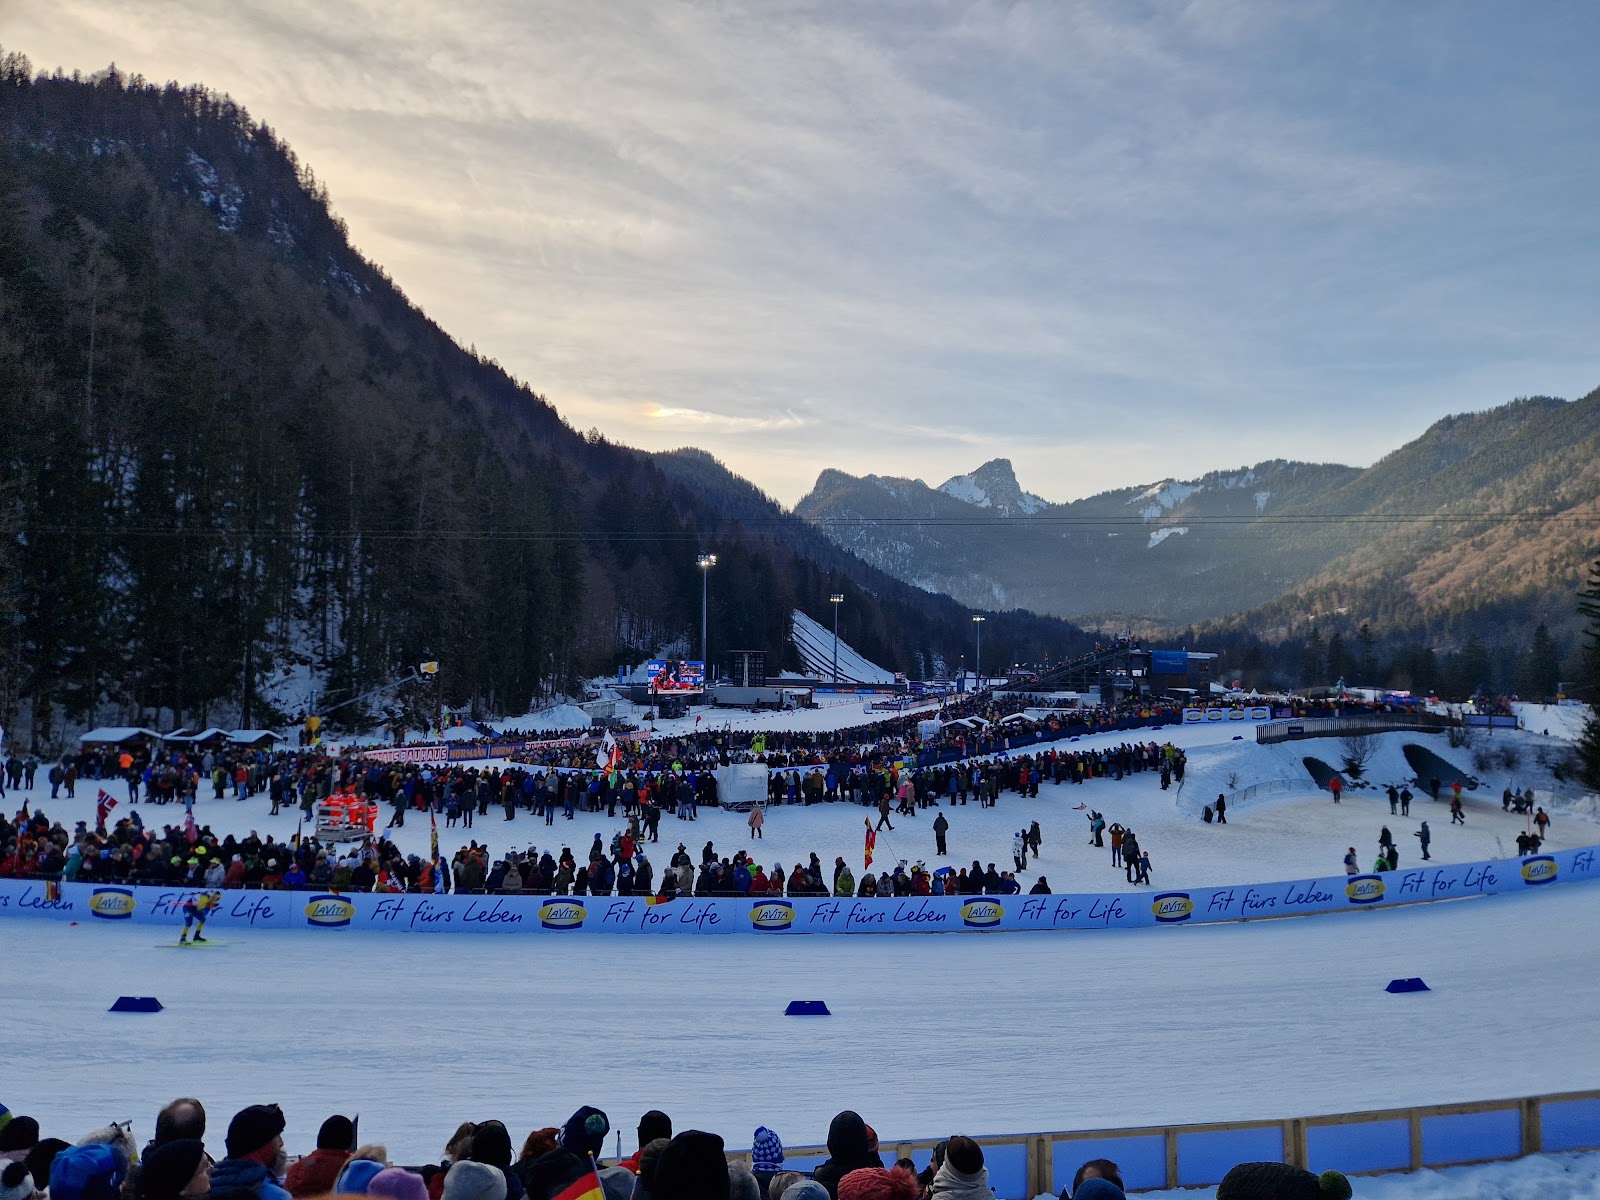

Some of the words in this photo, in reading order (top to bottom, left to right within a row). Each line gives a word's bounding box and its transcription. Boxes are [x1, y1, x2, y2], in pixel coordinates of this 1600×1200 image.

[401, 749, 447, 763] BAUHAUS
[1572, 850, 1595, 873] Fit
[1400, 871, 1425, 894] Fit
[1432, 870, 1457, 896] for
[1464, 865, 1498, 891] Life
[231, 896, 273, 924] Life
[1019, 898, 1046, 920] Fit
[1054, 899, 1081, 925] for
[1089, 898, 1126, 925] Life
[1208, 890, 1234, 912] Fit
[1241, 889, 1276, 915] fürs
[1284, 881, 1333, 904] Leben
[371, 898, 404, 921] Fit
[410, 900, 454, 928] fürs
[463, 899, 522, 922] Leben
[603, 901, 634, 923] Fit
[641, 907, 672, 930] for
[680, 903, 721, 930] Life
[810, 901, 840, 923] Fit
[846, 903, 885, 929] fürs
[894, 899, 946, 922] Leben
